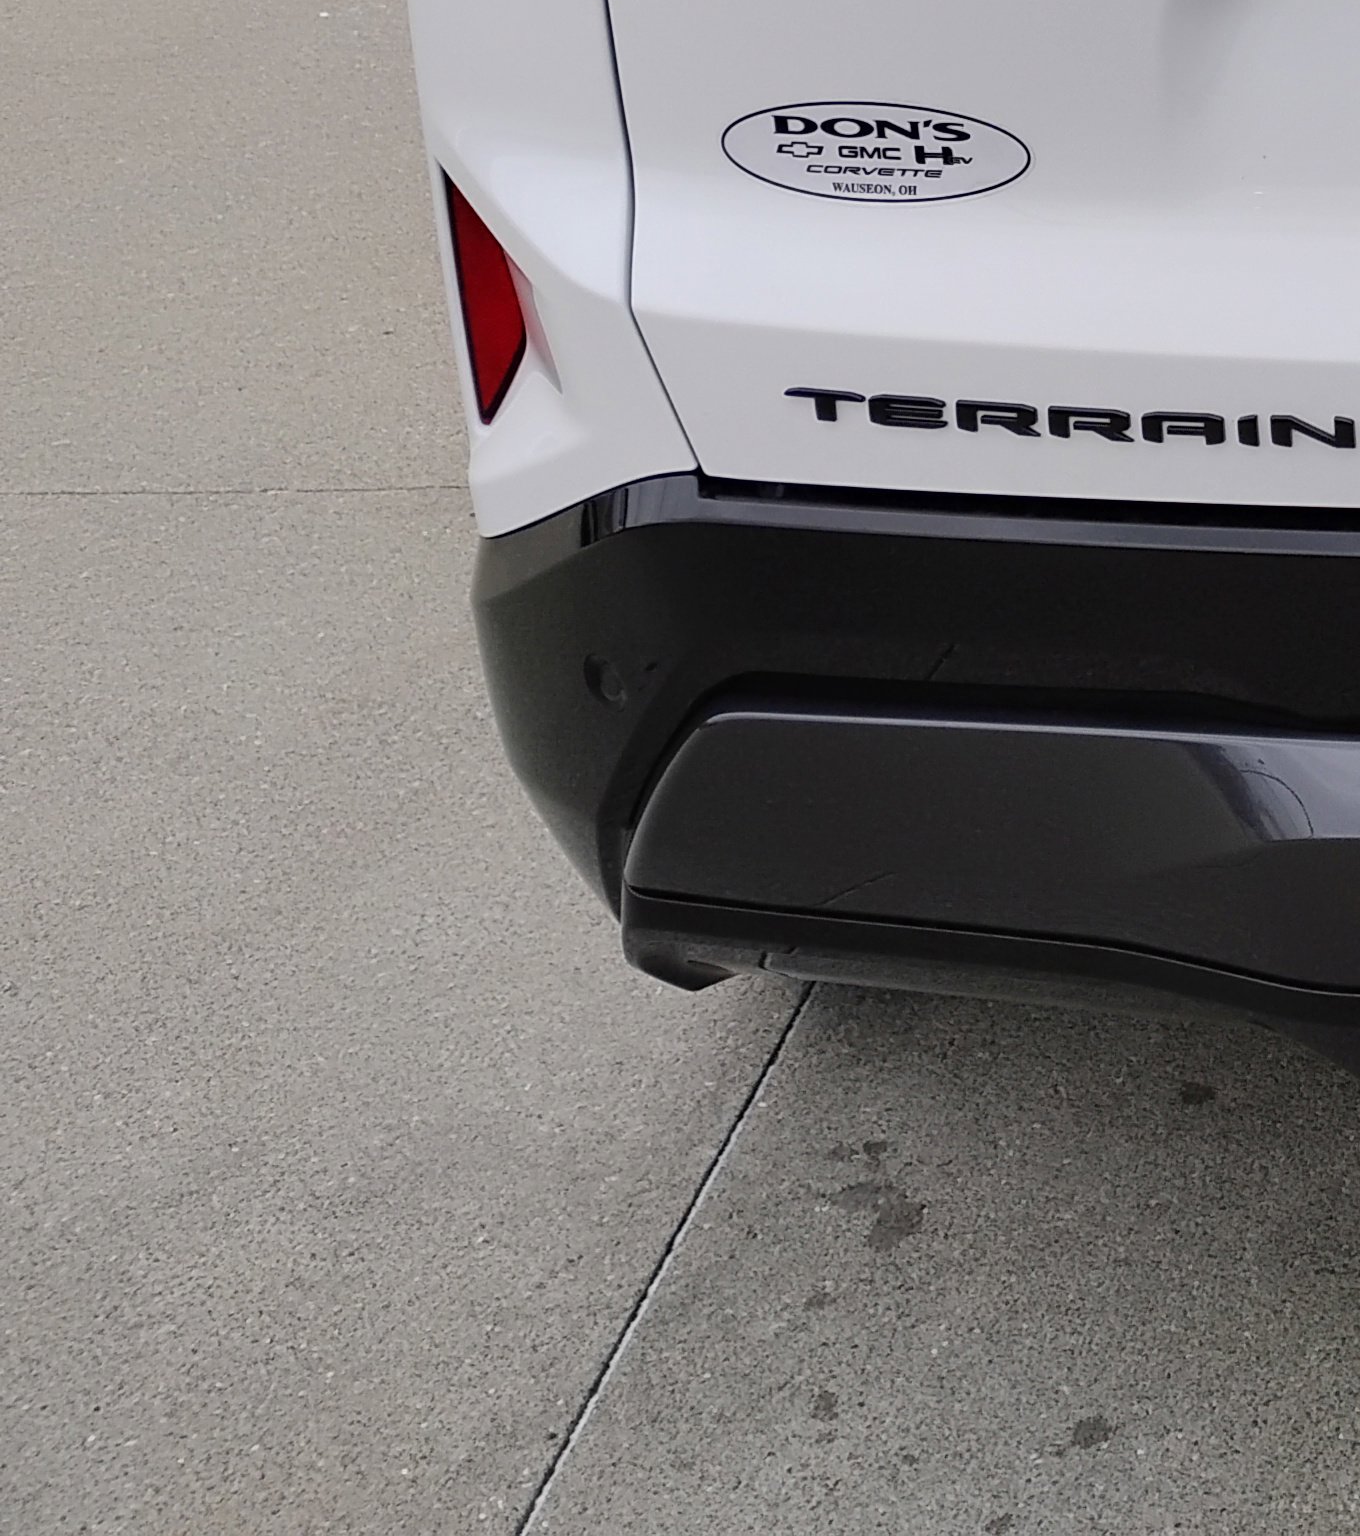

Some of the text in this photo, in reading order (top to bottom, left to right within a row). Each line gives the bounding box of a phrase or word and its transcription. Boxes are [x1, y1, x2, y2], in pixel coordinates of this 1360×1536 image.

[772, 114, 971, 142] DON'S
[838, 145, 902, 161] GMC
[806, 164, 943, 179] CORVETTE
[832, 182, 917, 197] WAUSEON, OH
[783, 387, 1357, 449] TERRAIN
